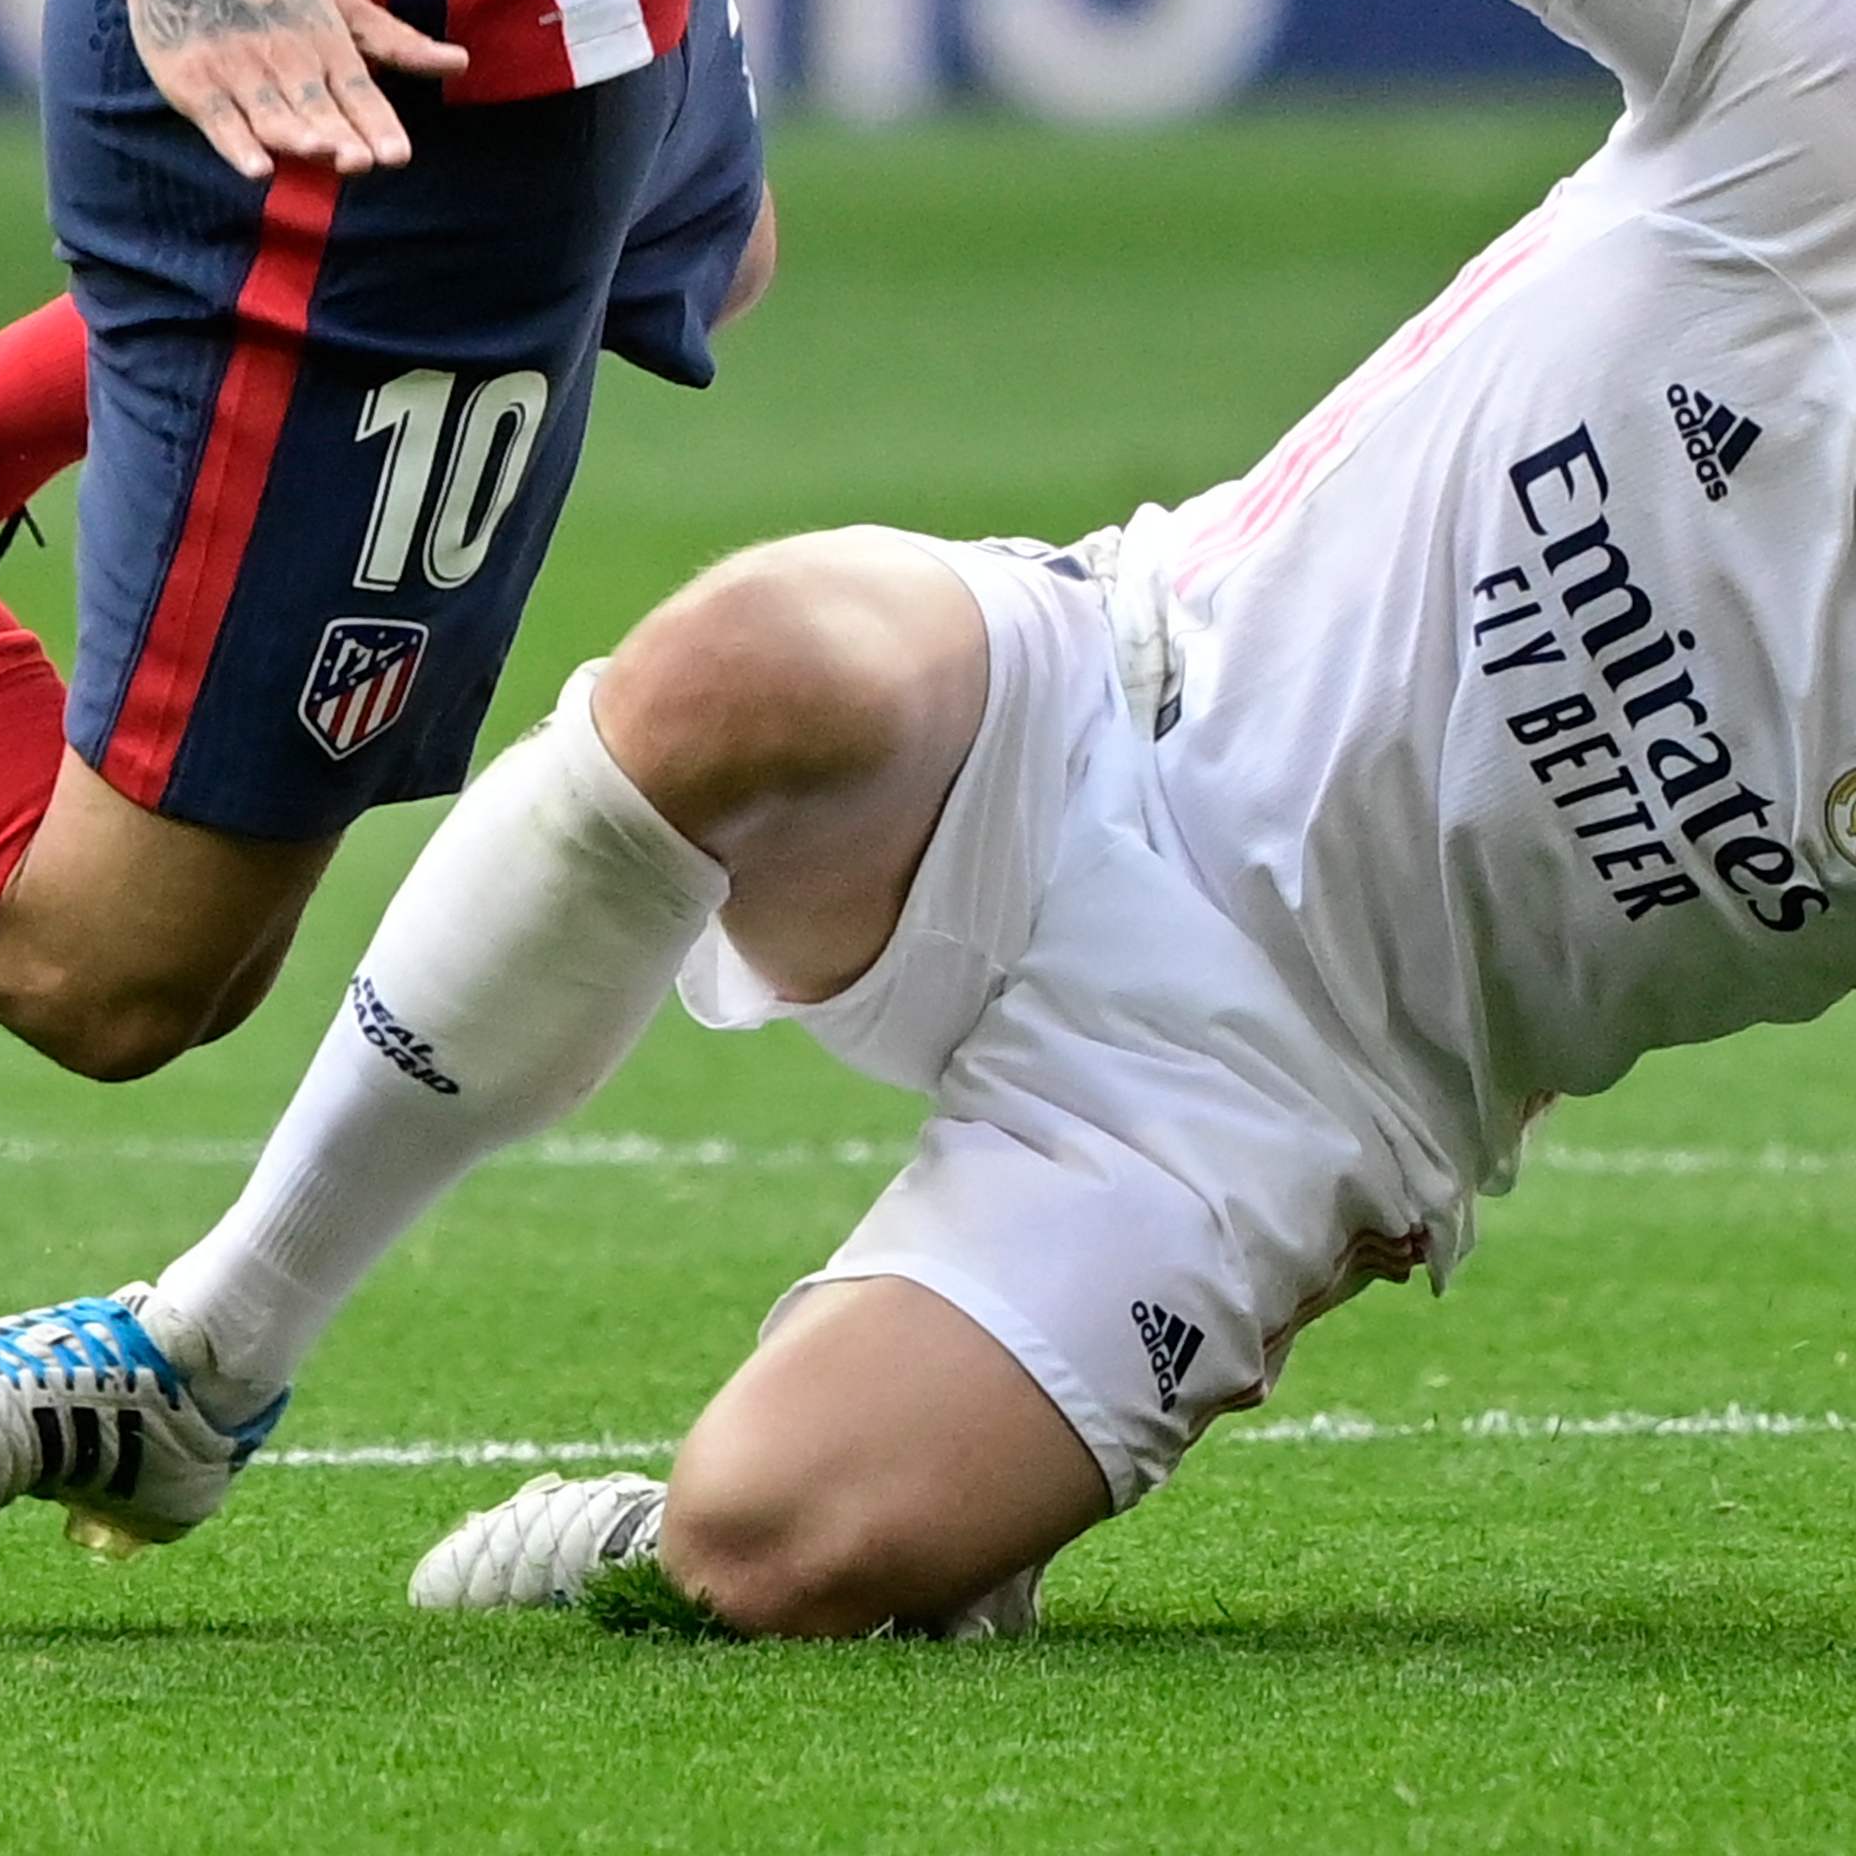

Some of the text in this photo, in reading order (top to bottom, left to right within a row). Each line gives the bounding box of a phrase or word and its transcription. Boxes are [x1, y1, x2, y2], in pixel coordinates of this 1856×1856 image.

[352, 367, 549, 593] 10
[1666, 382, 1729, 502] adidas
[1473, 565, 1701, 923] FLY BETTER
[1507, 420, 1831, 934] Emirates
[1130, 1299, 1177, 1414] adidas
